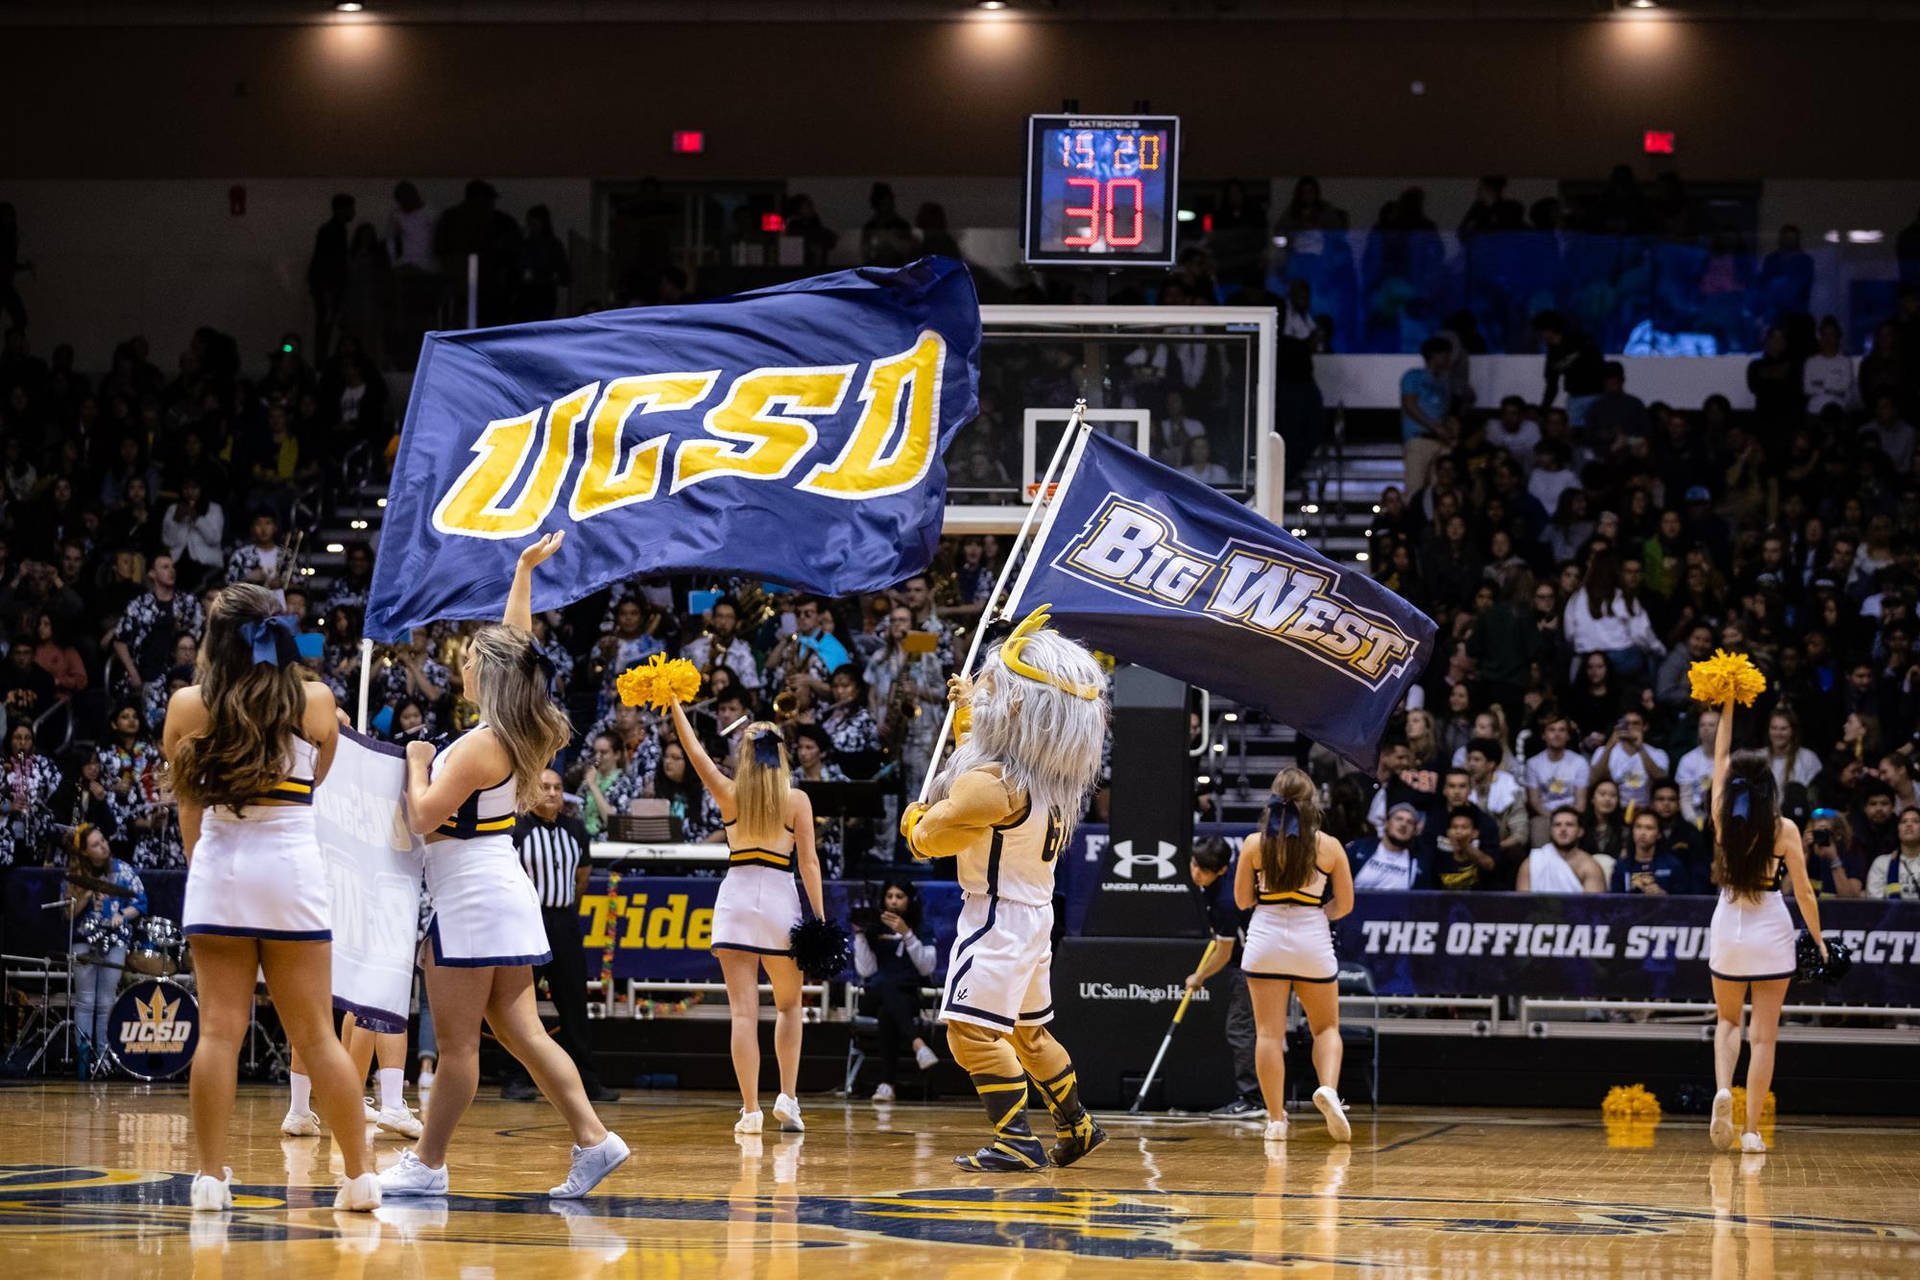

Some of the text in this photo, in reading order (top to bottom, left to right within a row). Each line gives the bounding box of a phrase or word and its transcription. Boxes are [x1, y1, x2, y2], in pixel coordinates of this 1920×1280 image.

[1068, 120, 1140, 128] DAKTRONICS
[1064, 176, 1144, 247] 30
[432, 329, 947, 540] UCSD
[1102, 882, 1187, 892] UNDER ARMOUR
[578, 893, 715, 949] Tide
[1362, 920, 1439, 954] THE
[1445, 922, 1616, 958] OFFICIAL
[1080, 982, 1210, 1004] UC San Diego Helth
[120, 1021, 192, 1043] UCSD
